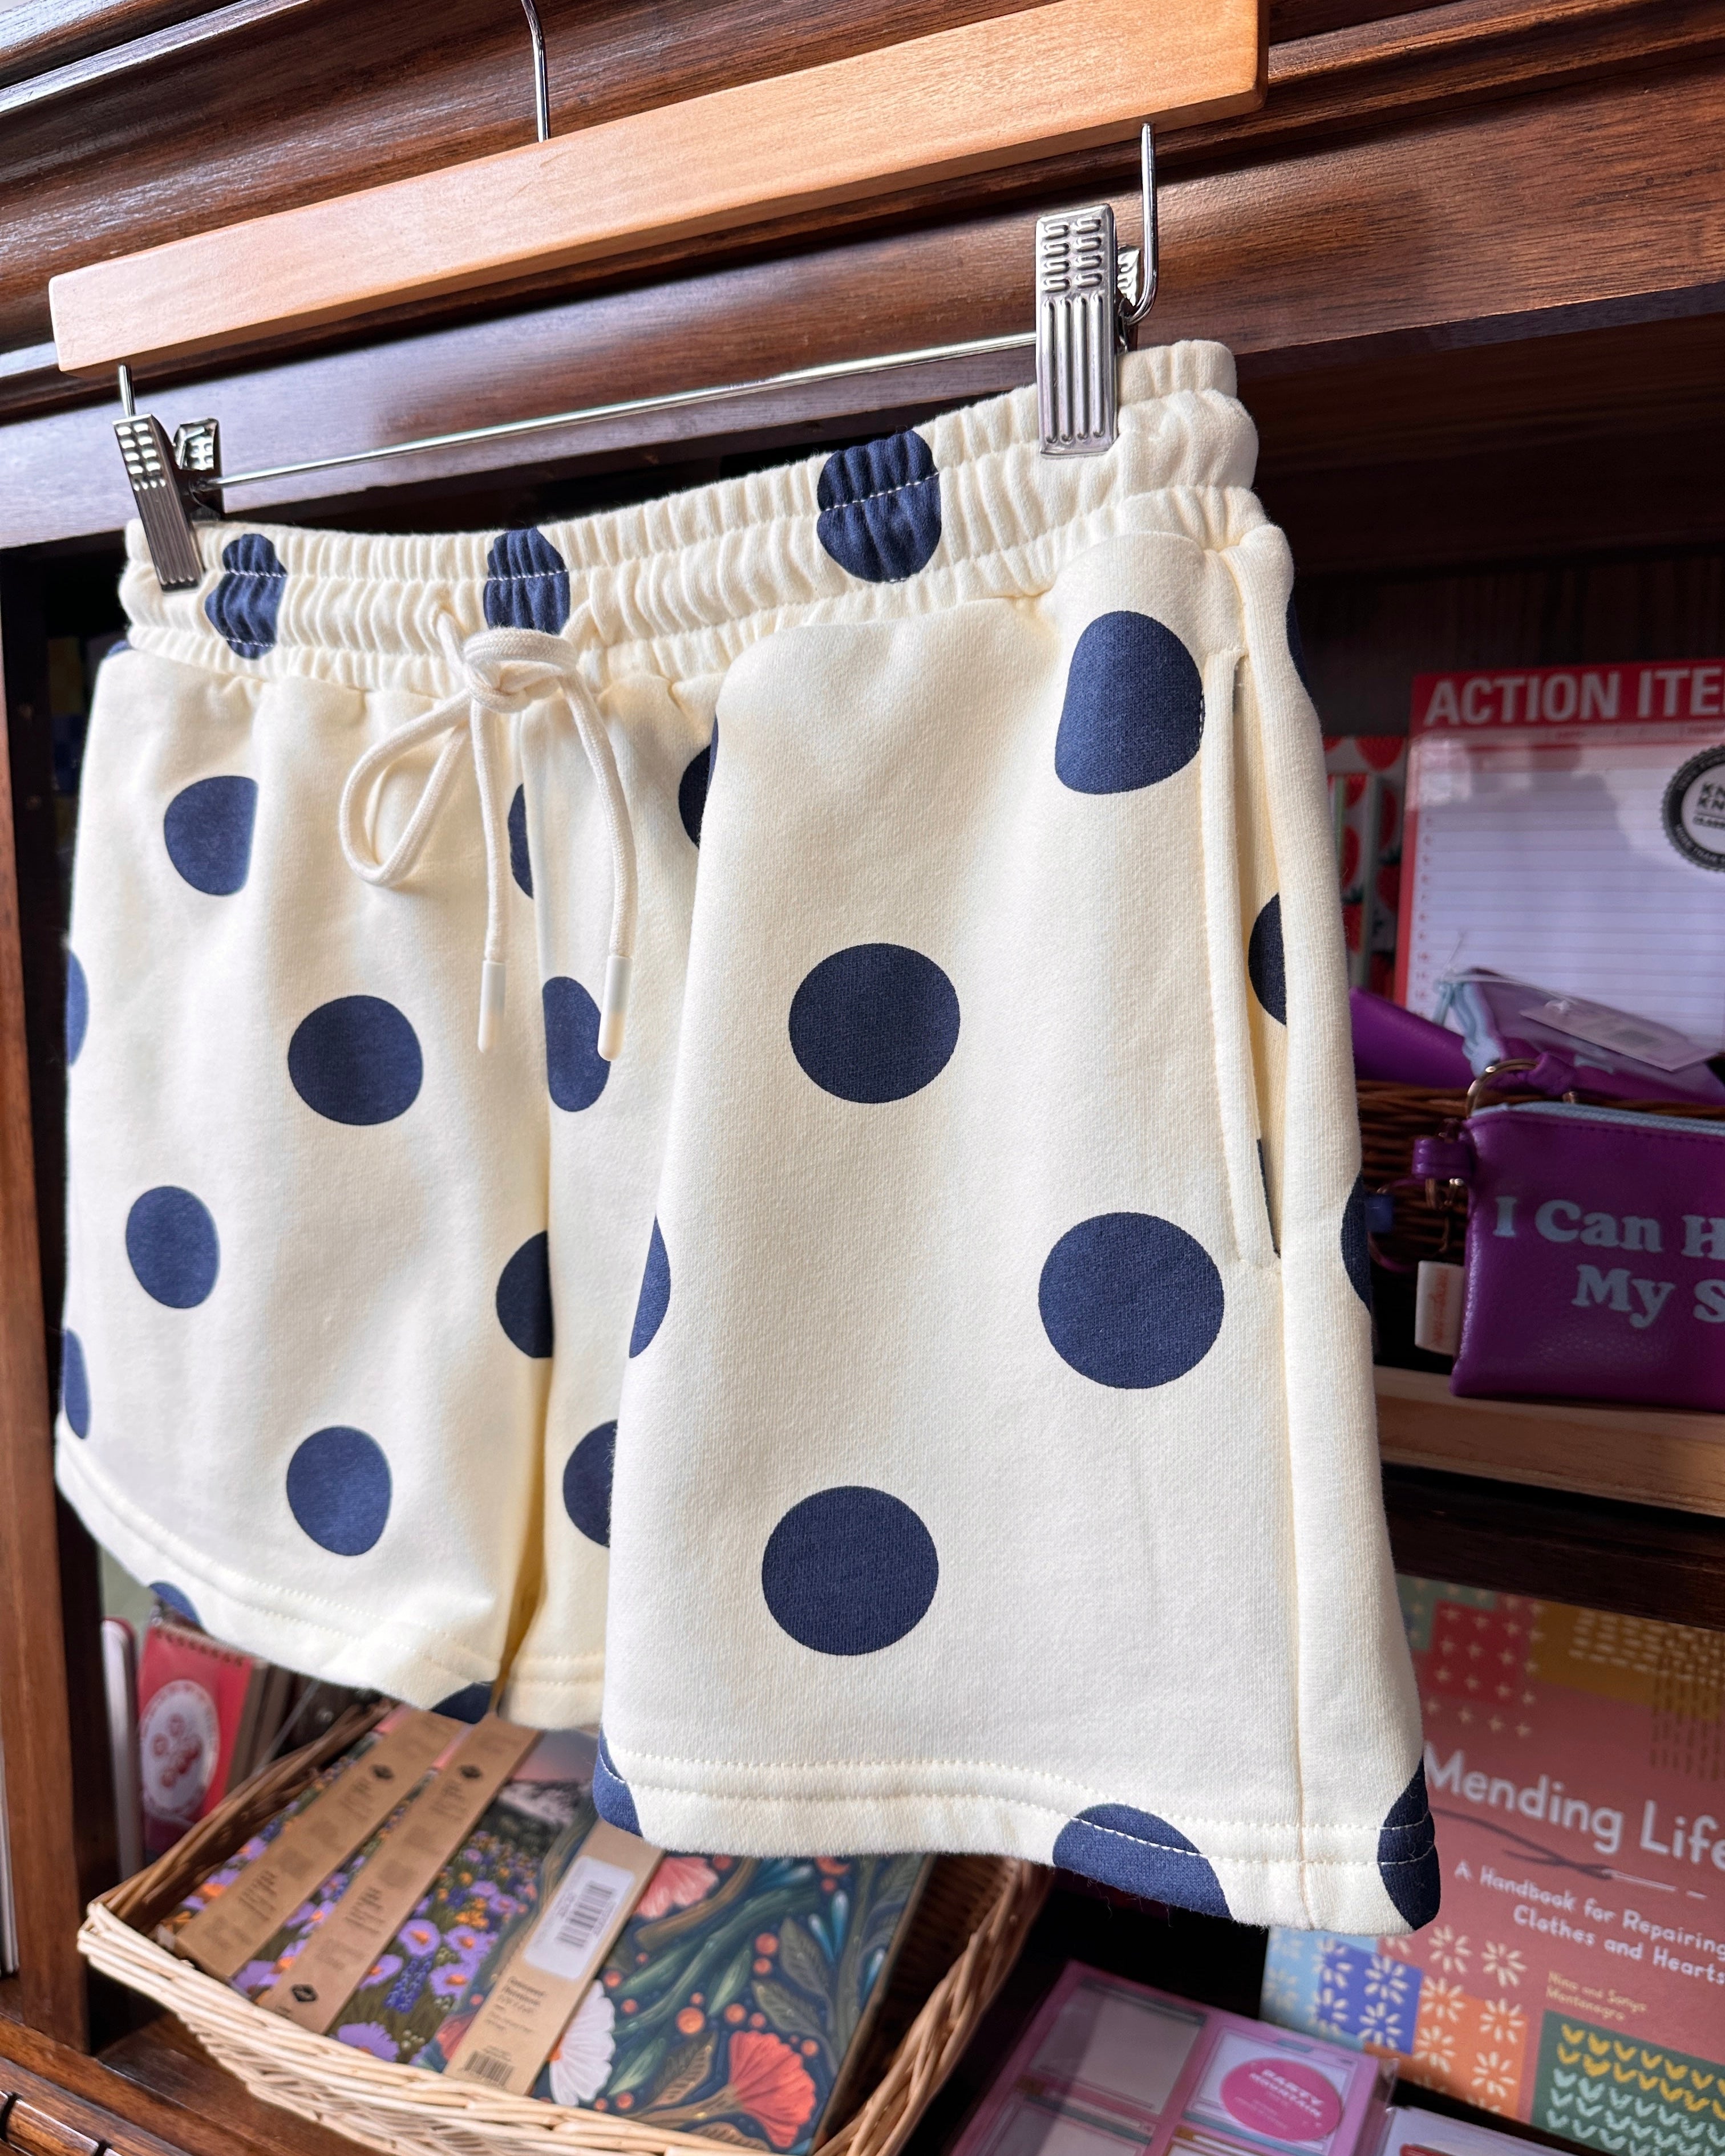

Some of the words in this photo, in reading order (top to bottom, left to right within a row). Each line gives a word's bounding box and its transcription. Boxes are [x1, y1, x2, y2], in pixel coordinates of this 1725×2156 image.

[1426, 671, 1619, 725] ACTION
[1637, 667, 1725, 718] ITE
[1493, 1195, 1519, 1238] I
[1534, 1199, 1663, 1253] Can
[1572, 1264, 1675, 1328] My
[1424, 1741, 1623, 1855] Mending
[1455, 1860, 1472, 1881] A
[1480, 1865, 1577, 1912] Handbook
[1583, 1897, 1617, 1923] for
[1622, 1908, 1725, 1962] Repairing
[1513, 1904, 1596, 1946] Clothes
[1604, 1939, 1645, 1961] and
[1653, 1945, 1725, 1985] Hearts
